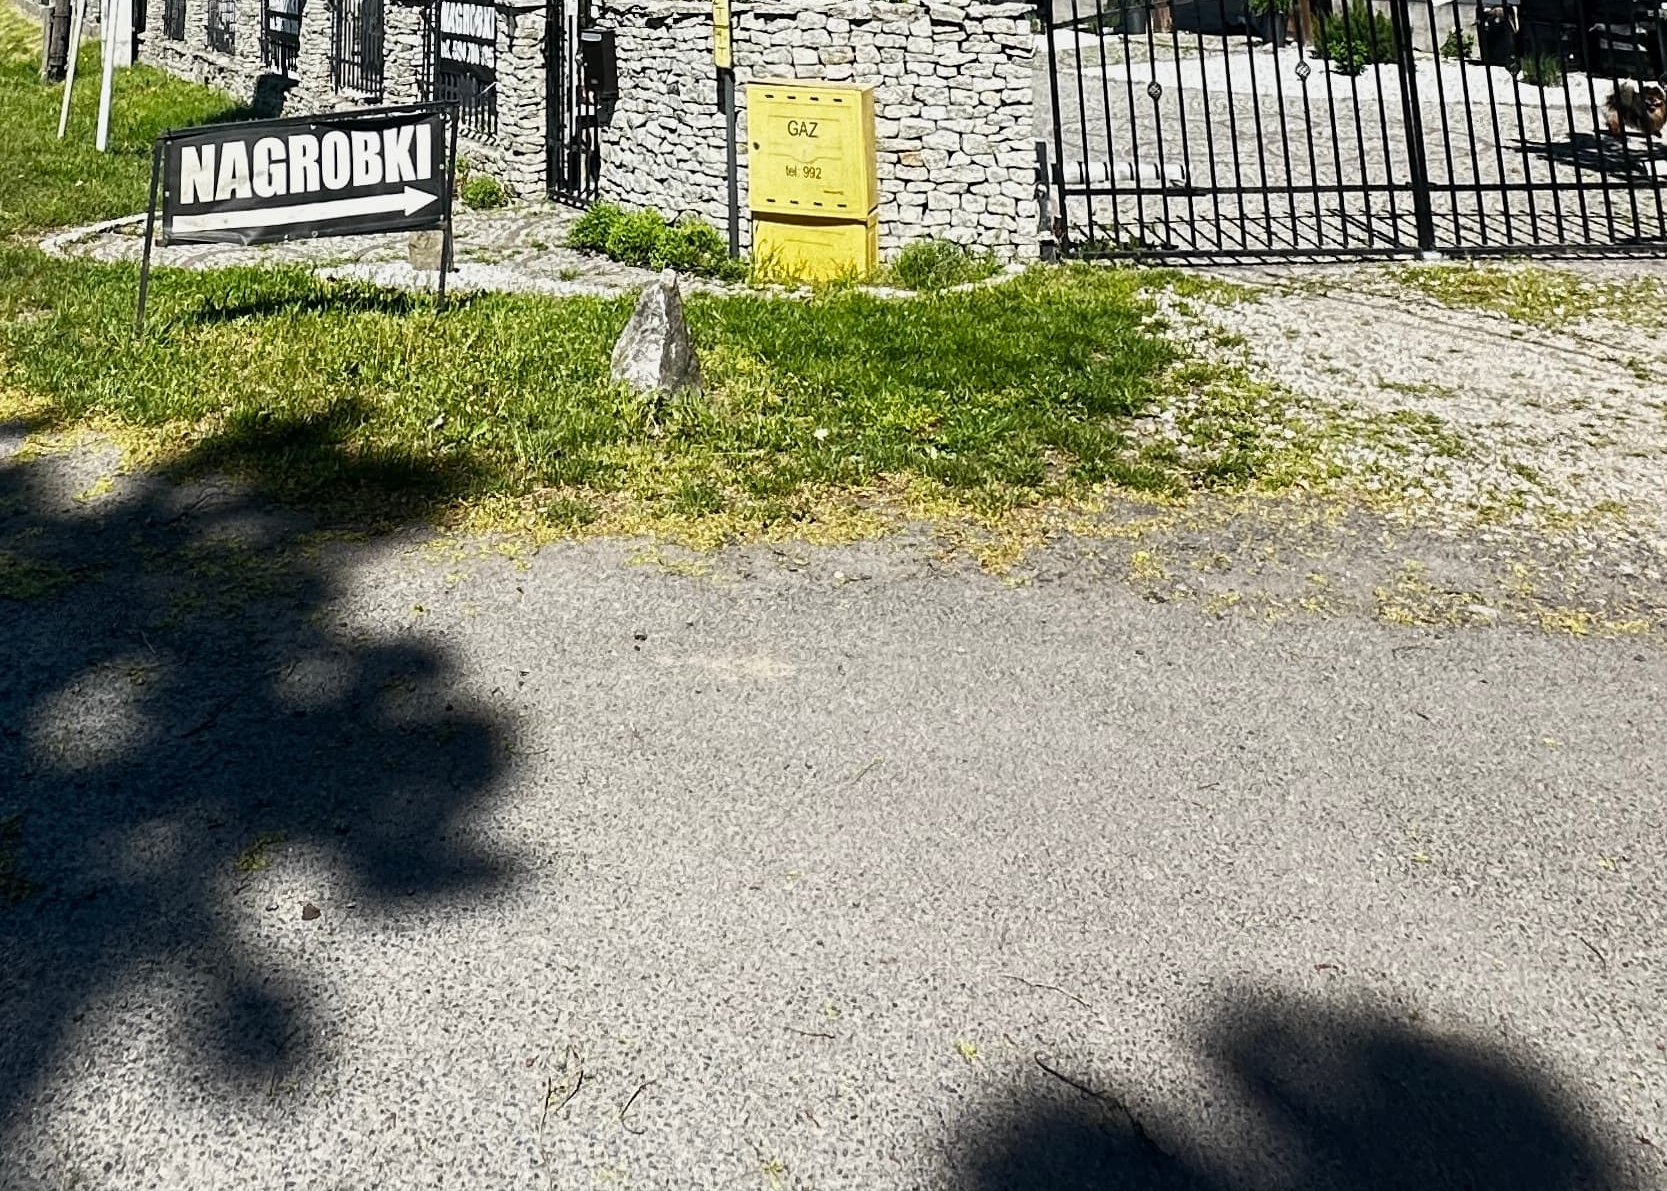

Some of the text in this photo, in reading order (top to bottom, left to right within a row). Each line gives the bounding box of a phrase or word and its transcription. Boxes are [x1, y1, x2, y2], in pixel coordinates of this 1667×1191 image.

[787, 120, 819, 138] GAZ
[179, 123, 432, 205] NAGROBKI
[802, 166, 823, 180] 992
